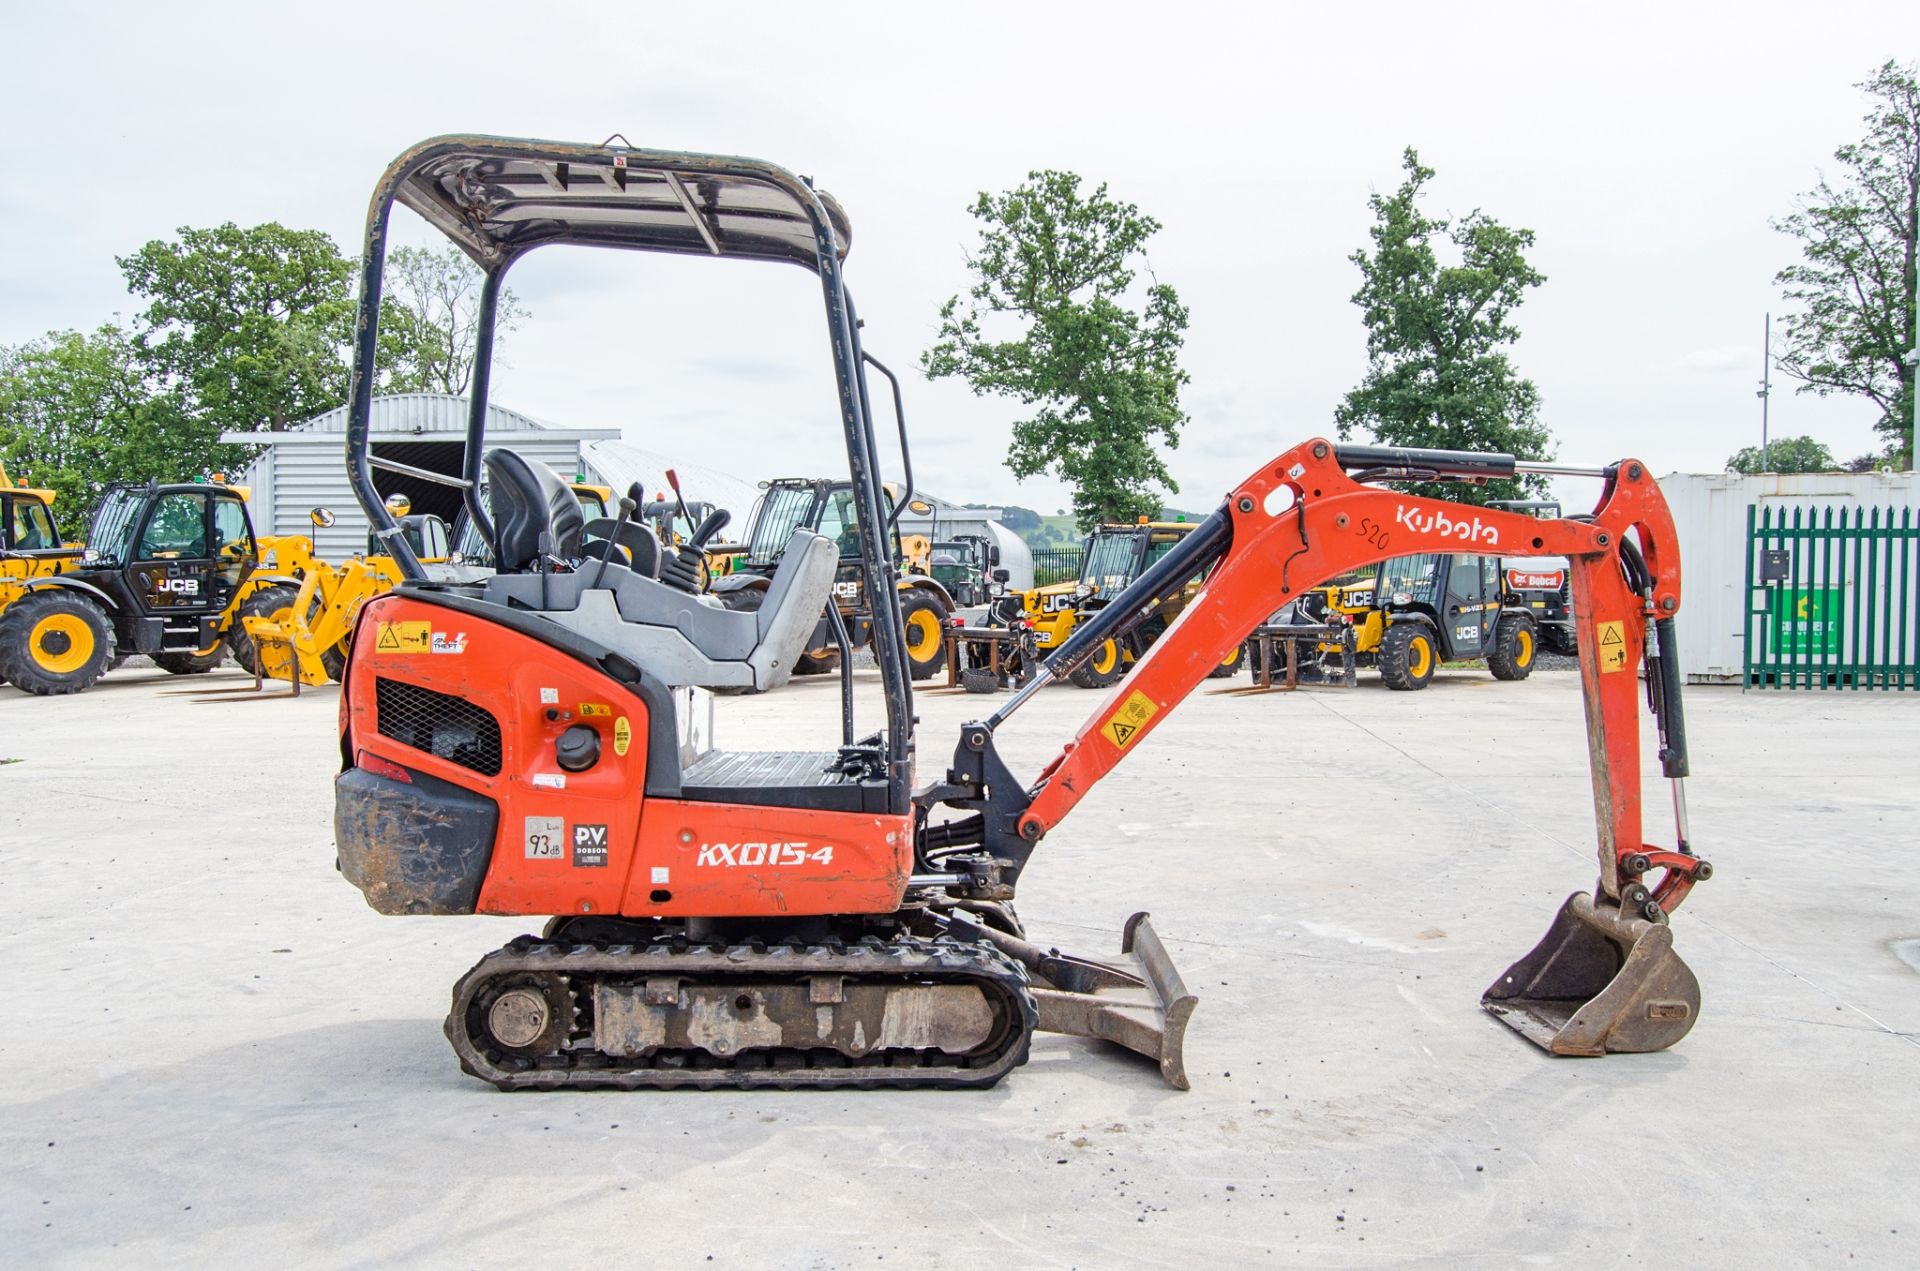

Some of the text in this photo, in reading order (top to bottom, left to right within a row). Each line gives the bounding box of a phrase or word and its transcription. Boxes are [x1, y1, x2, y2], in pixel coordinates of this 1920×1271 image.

[1396, 504, 1499, 545] Kubota
[1355, 517, 1390, 551] S20
[158, 579, 199, 592] JCB
[1528, 574, 1558, 587] Bobcat
[1344, 591, 1373, 608] JCB
[1456, 626, 1478, 640] JCB
[530, 834, 560, 855] 93 dB
[575, 827, 607, 845] P.V.
[696, 842, 834, 867] KX015-4
